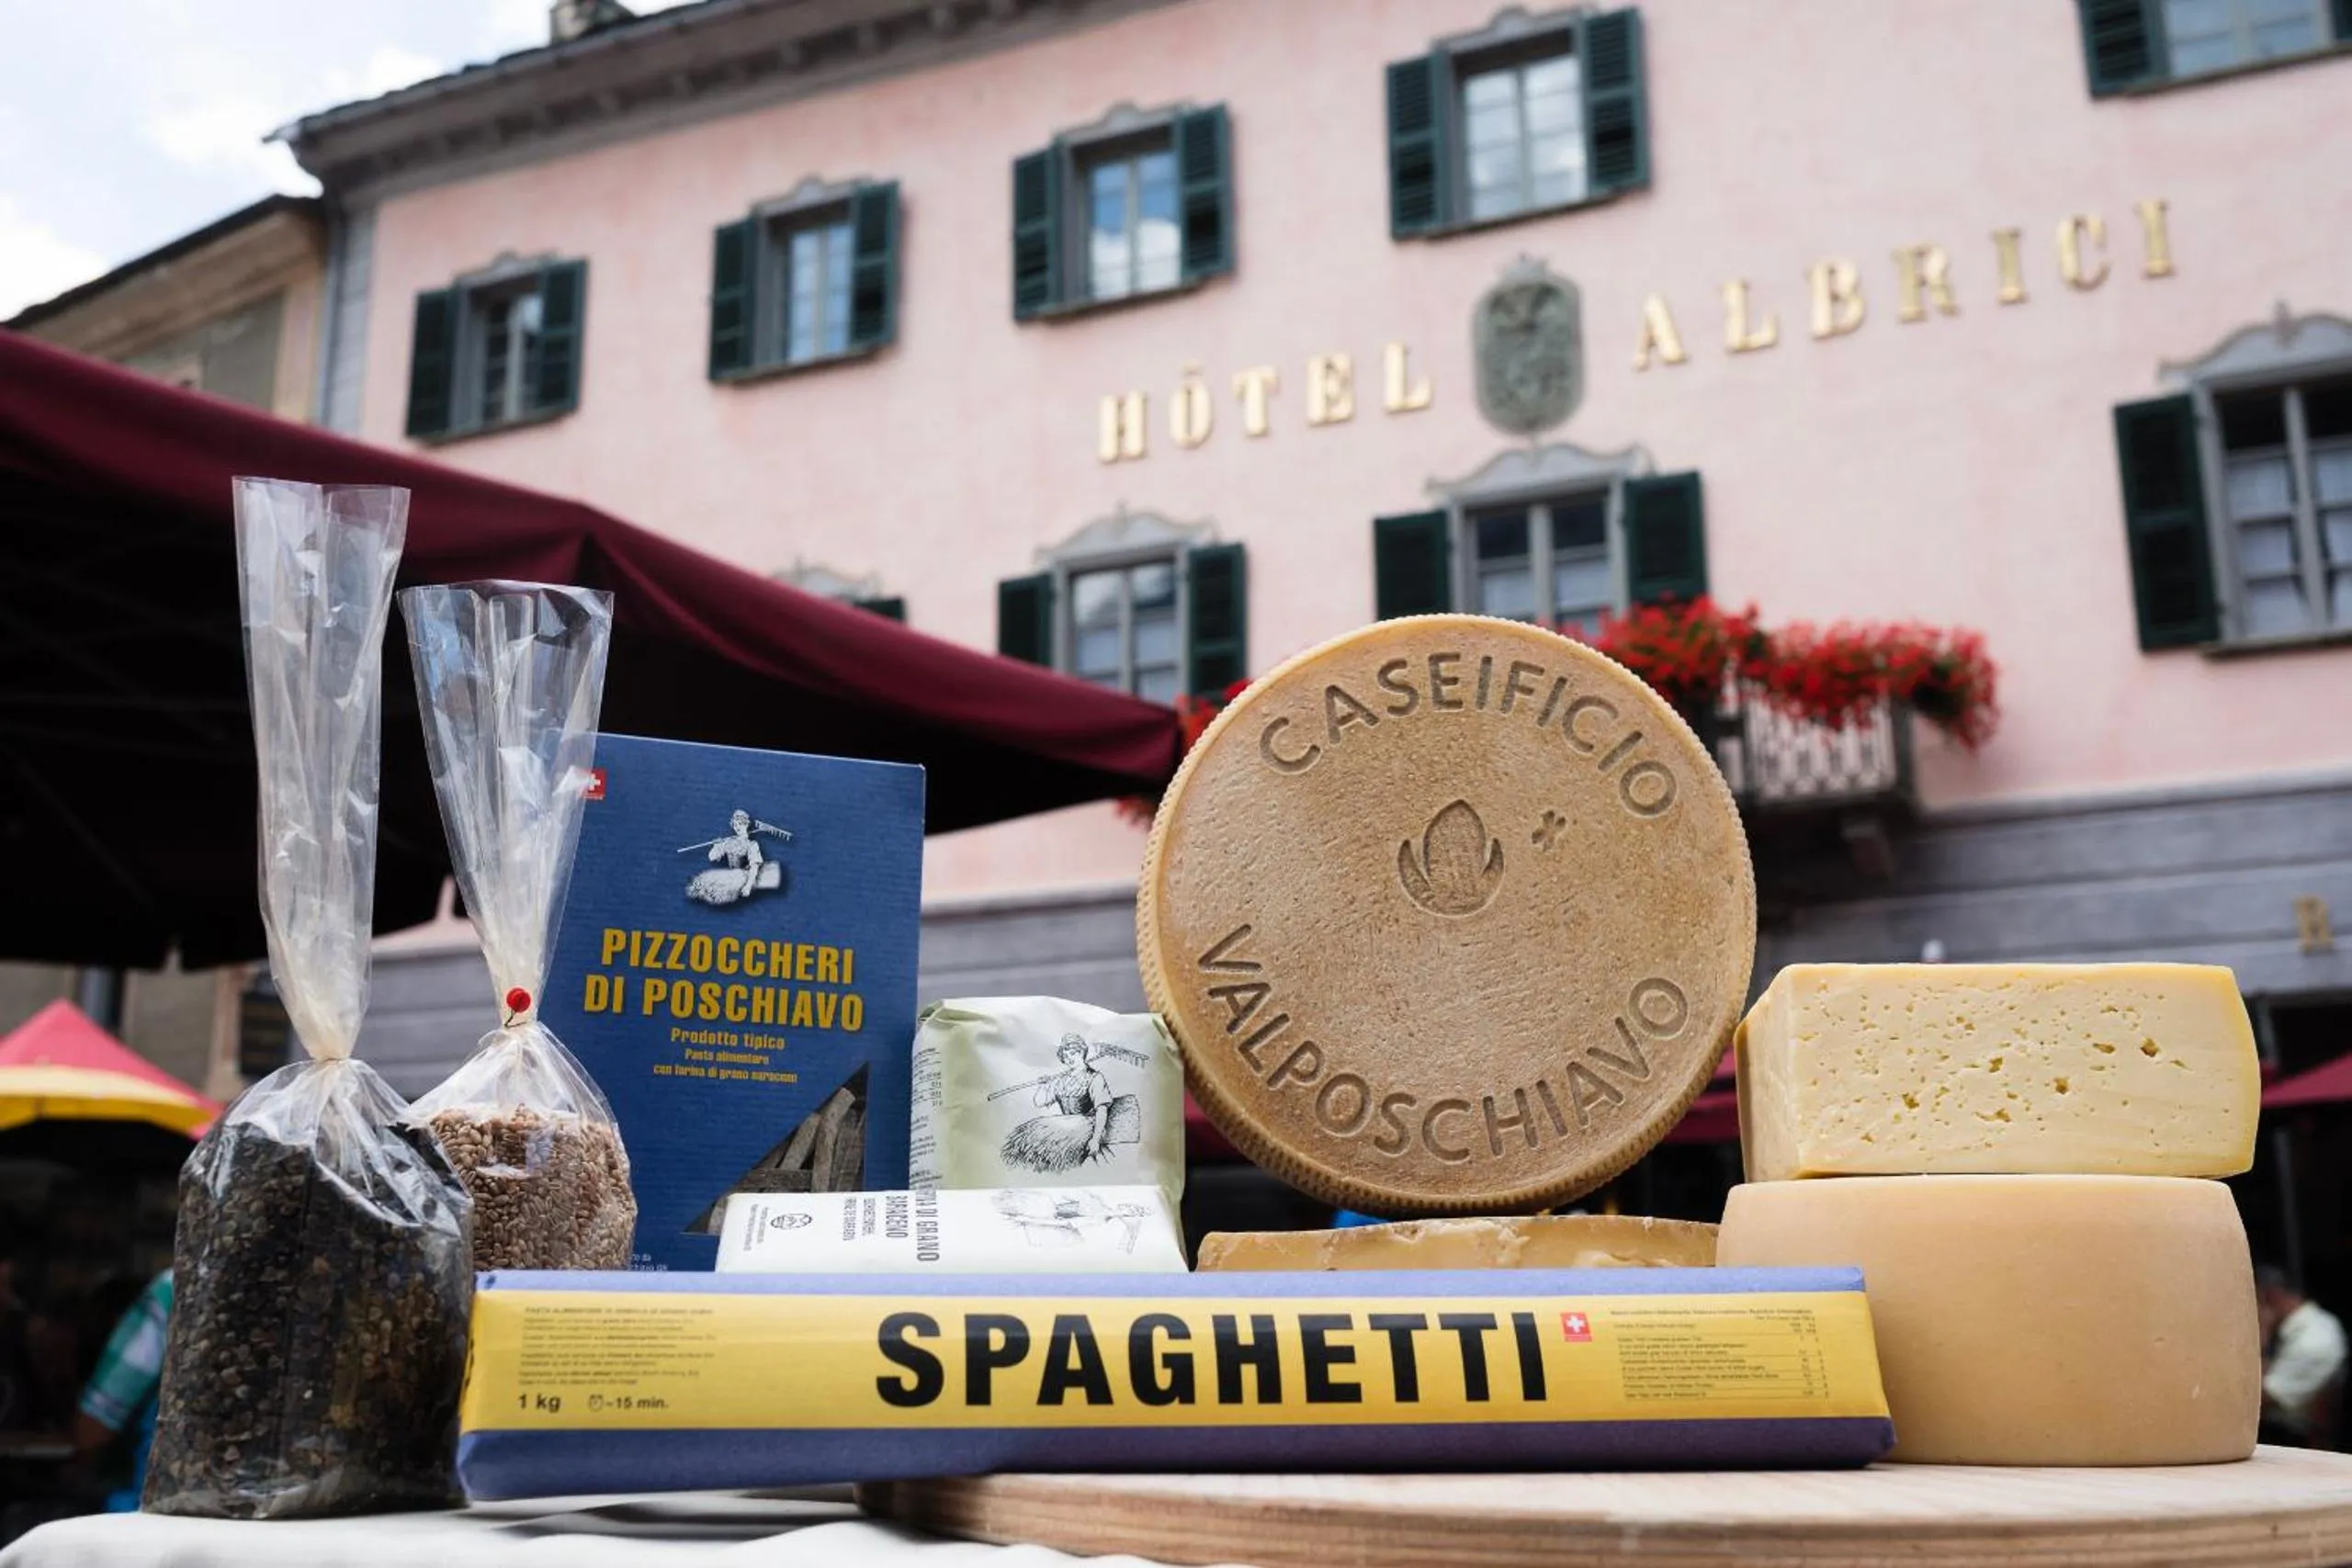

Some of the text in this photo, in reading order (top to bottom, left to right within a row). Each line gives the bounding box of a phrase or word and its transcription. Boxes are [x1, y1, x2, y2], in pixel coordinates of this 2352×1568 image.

[1632, 199, 2177, 371] ALBRICI
[1260, 651, 1679, 819] CASEIFICIO
[601, 927, 854, 985] PIZZOCCHERI
[583, 974, 865, 1032] DI POSCHIAVO
[671, 1027, 786, 1050] Prodotto tipico
[684, 1048, 714, 1061] Pasta
[1196, 922, 1690, 1164] VALPOSCHIAVO
[653, 1064, 672, 1076] con
[916, 1220, 940, 1262] GRANO
[875, 1311, 1548, 1407] SPAGHETTI
[517, 1393, 527, 1409] 1
[536, 1393, 561, 1414] kg
[636, 1395, 670, 1409] min.
